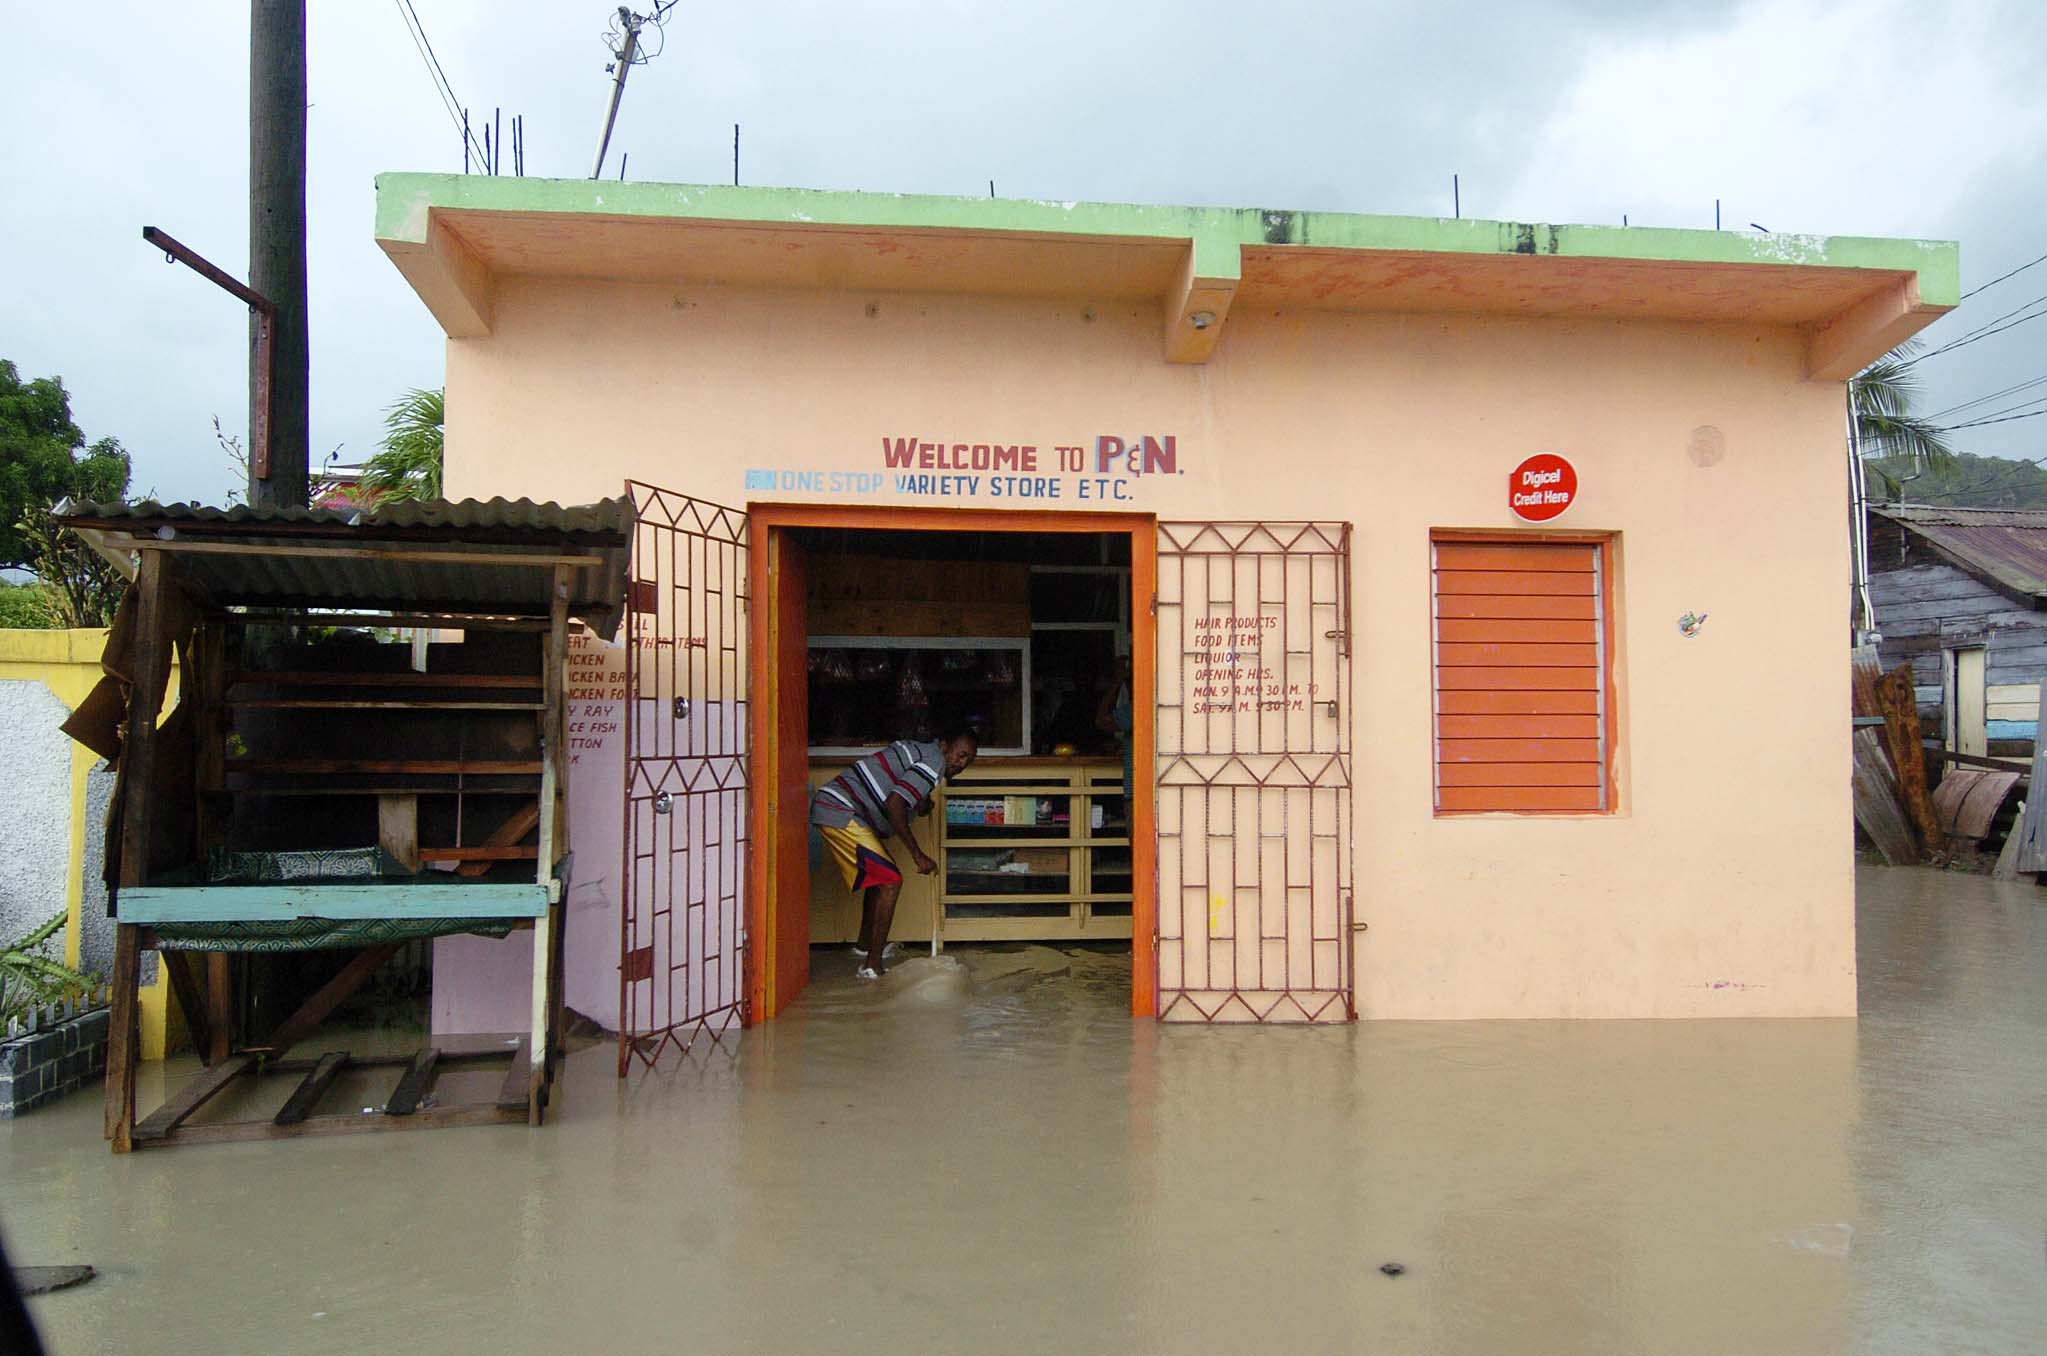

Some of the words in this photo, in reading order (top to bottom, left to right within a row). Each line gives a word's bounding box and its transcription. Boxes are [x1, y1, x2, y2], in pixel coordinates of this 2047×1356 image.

[883, 437, 1037, 472] WELCOME
[1054, 446, 1085, 473] TO
[1522, 469, 1561, 487] Digicel
[781, 471, 826, 492] ONE
[829, 472, 883, 494] STOP
[895, 473, 980, 496] VARIETY
[990, 476, 1061, 498] STORE
[1078, 479, 1134, 500] ETC.
[1513, 491, 1543, 507] Credit
[1544, 490, 1569, 504] Here
[1194, 618, 1221, 629] HAIR
[568, 637, 592, 649] EAT
[1194, 634, 1223, 647] FOOD
[568, 655, 605, 666] ICKEN
[568, 671, 604, 683] ICKEN
[1195, 668, 1244, 681] OPENING
[568, 688, 605, 700] ICKEN
[584, 705, 614, 717] RAY
[590, 722, 617, 733] FISH
[571, 738, 603, 749] TTON
